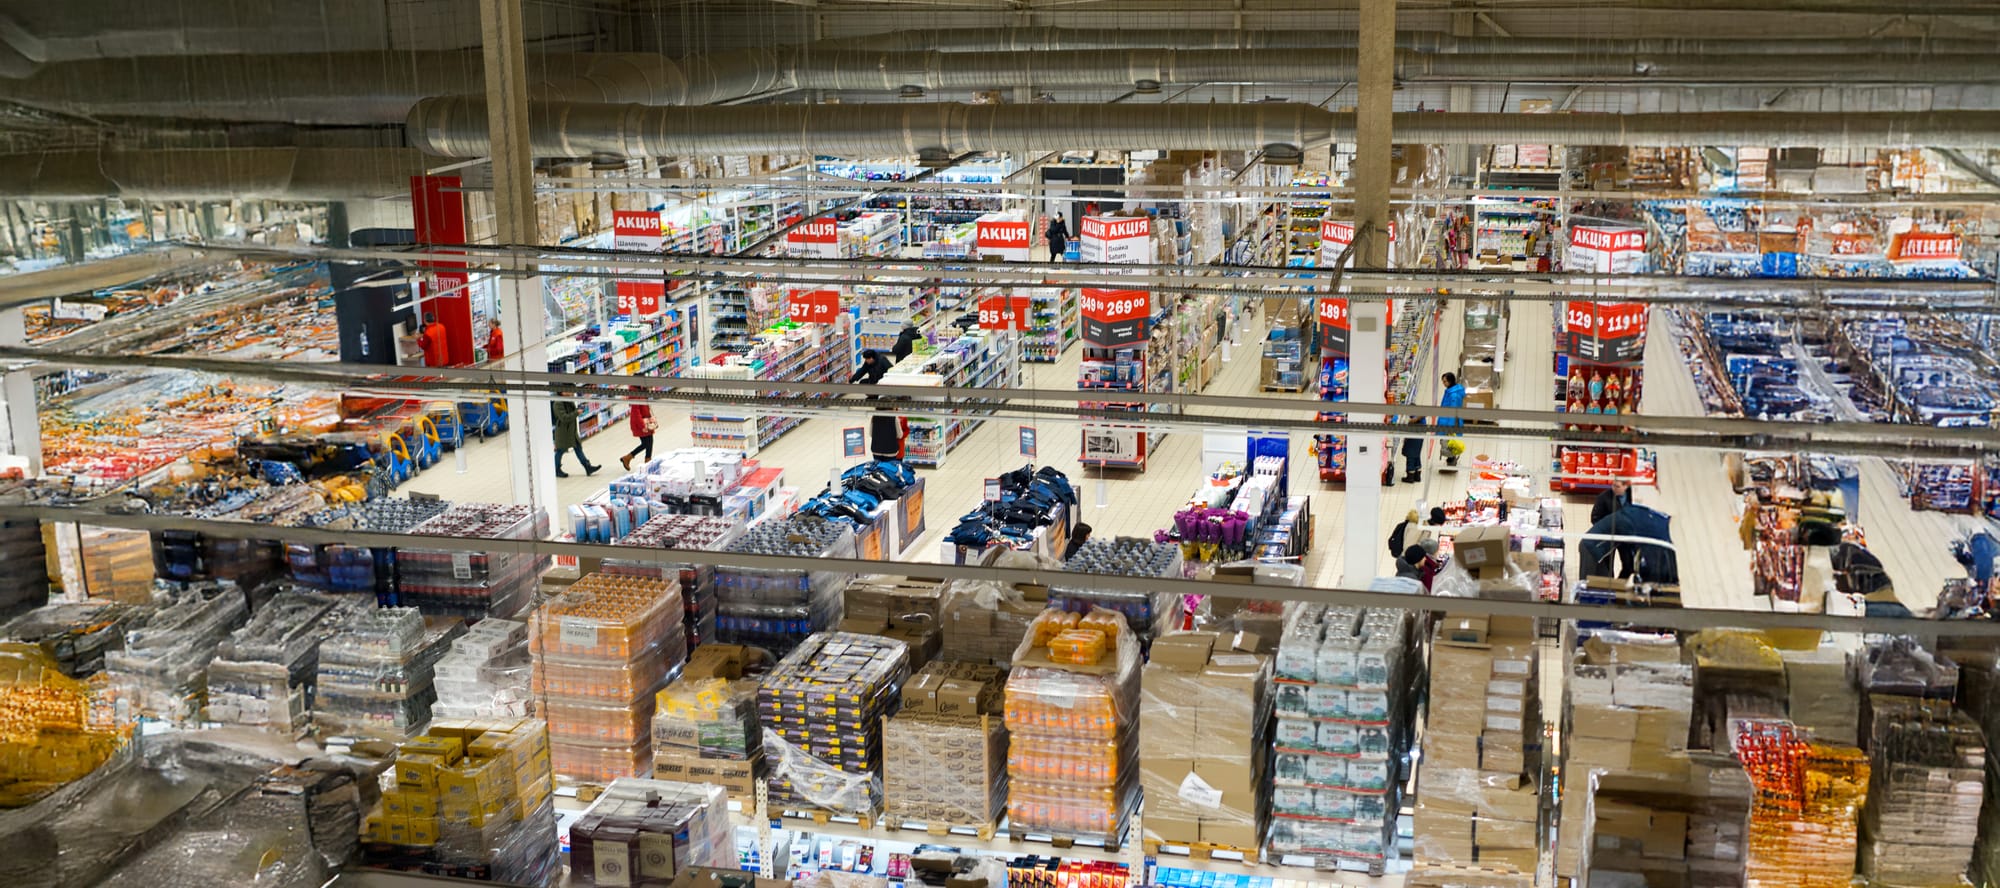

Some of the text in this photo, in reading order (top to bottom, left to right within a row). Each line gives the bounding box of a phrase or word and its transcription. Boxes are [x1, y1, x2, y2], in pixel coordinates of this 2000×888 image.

[616, 216, 660, 231] АКЦІЯ
[1082, 219, 1106, 238] АКЦІЯ
[1108, 220, 1148, 238] АКЦІЯ
[979, 227, 1027, 243] АКЦІЯ
[1324, 223, 1354, 243] АКЦІЯ
[1574, 229, 1611, 249] АКЦІЯ
[618, 295, 637, 309] 53
[790, 303, 810, 317] 57
[1106, 297, 1145, 317] 269 00
[1320, 302, 1340, 320] 189
[978, 309, 1000, 325] 85
[1568, 310, 1592, 329] 129
